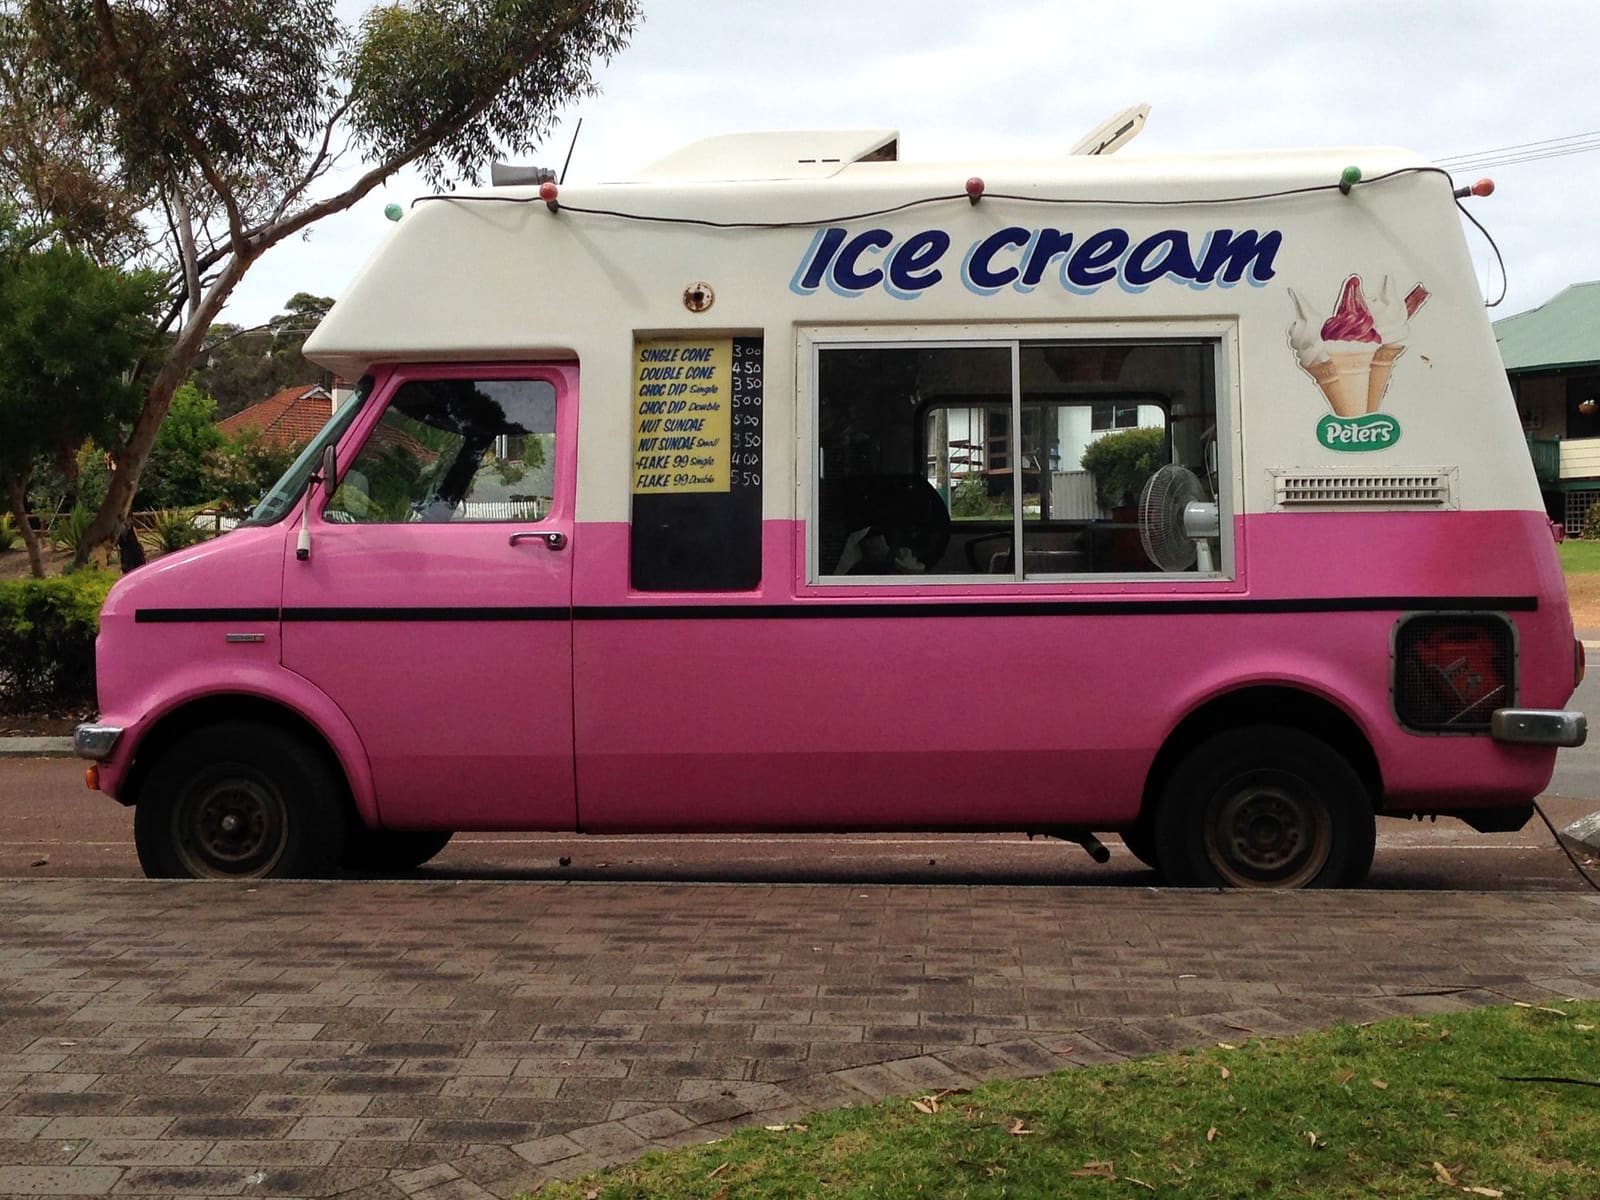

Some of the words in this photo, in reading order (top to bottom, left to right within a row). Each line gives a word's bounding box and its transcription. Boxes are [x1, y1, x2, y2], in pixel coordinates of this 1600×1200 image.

[640, 349, 680, 362] SINGLE
[680, 348, 714, 362] CONE
[640, 367, 684, 381] DOUBLE
[685, 366, 716, 380] CONE
[732, 362, 741, 374] 4
[744, 361, 761, 374] 50
[639, 384, 667, 397] CHOC
[667, 383, 688, 396] DIP
[689, 384, 719, 397] Single
[733, 376, 742, 391] 3
[746, 377, 762, 390] 50
[639, 401, 667, 415] CHOC
[667, 400, 687, 414] DIP
[688, 402, 720, 412] Double
[732, 394, 742, 408] 5
[638, 418, 662, 433] NUT
[663, 418, 706, 433] SUNDAE
[1325, 421, 1394, 444] Peters
[638, 437, 659, 452] NUT
[658, 436, 697, 451] SUNDAE
[697, 438, 720, 448] Small
[636, 455, 671, 470] FLAKE
[672, 454, 690, 469] 99
[636, 474, 671, 489] FLAKE
[673, 474, 689, 486] 99
[688, 475, 715, 485] Double
